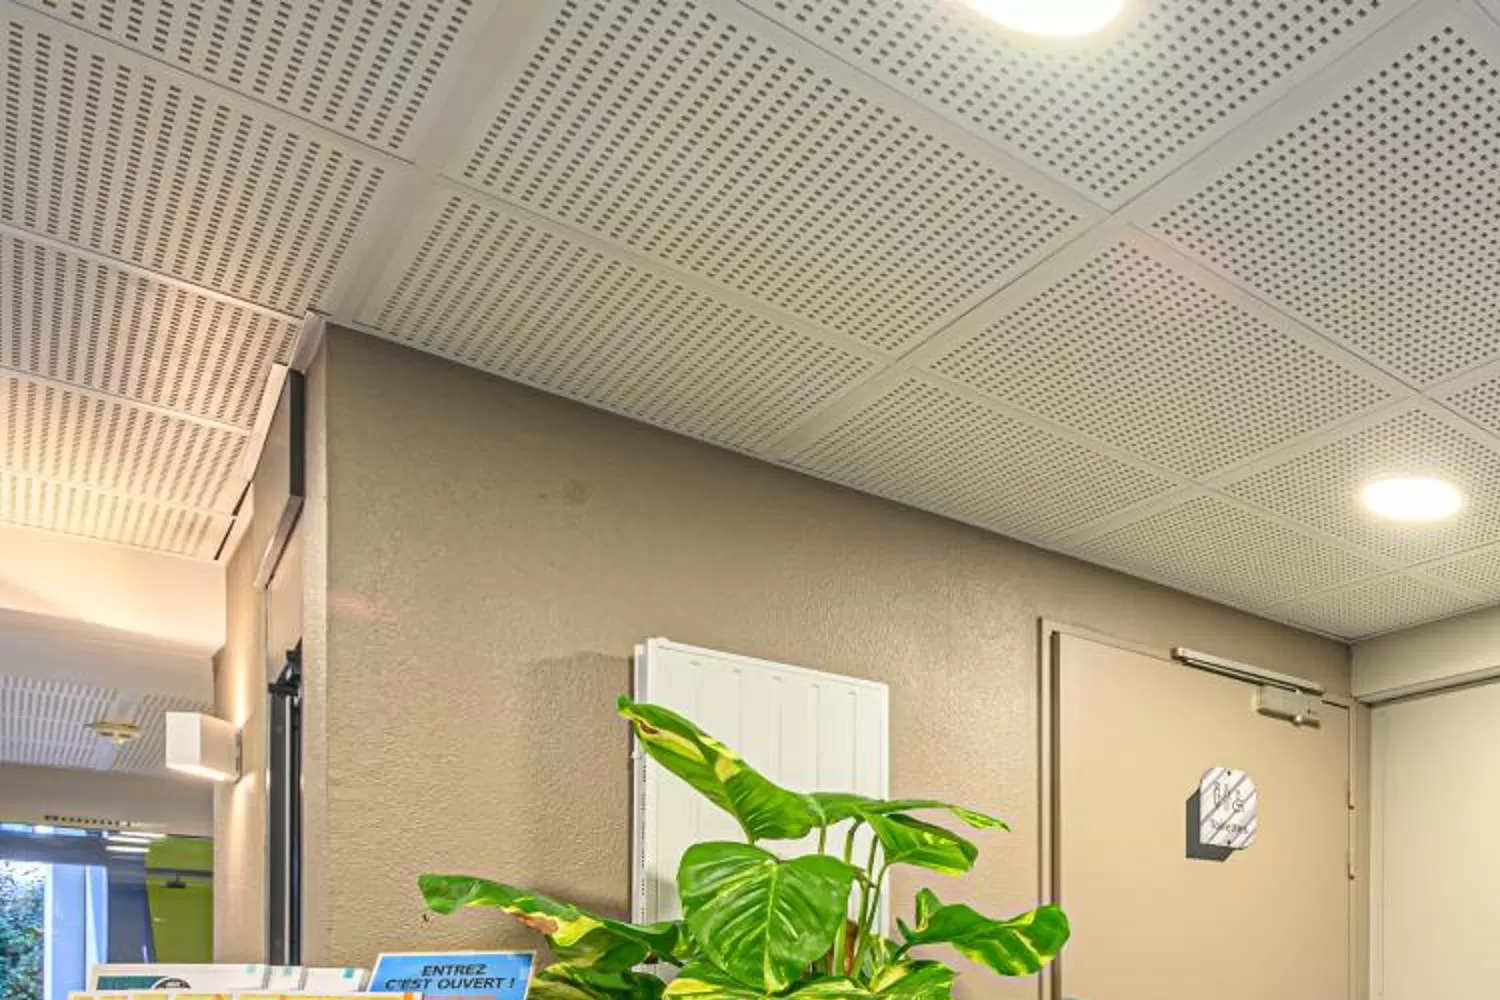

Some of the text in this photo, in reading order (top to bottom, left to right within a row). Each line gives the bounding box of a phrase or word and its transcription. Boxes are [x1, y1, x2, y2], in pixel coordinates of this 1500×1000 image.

[420, 963, 487, 977] ENTREZ
[384, 978, 431, 991] C'EST
[437, 977, 505, 989] OUVERT
